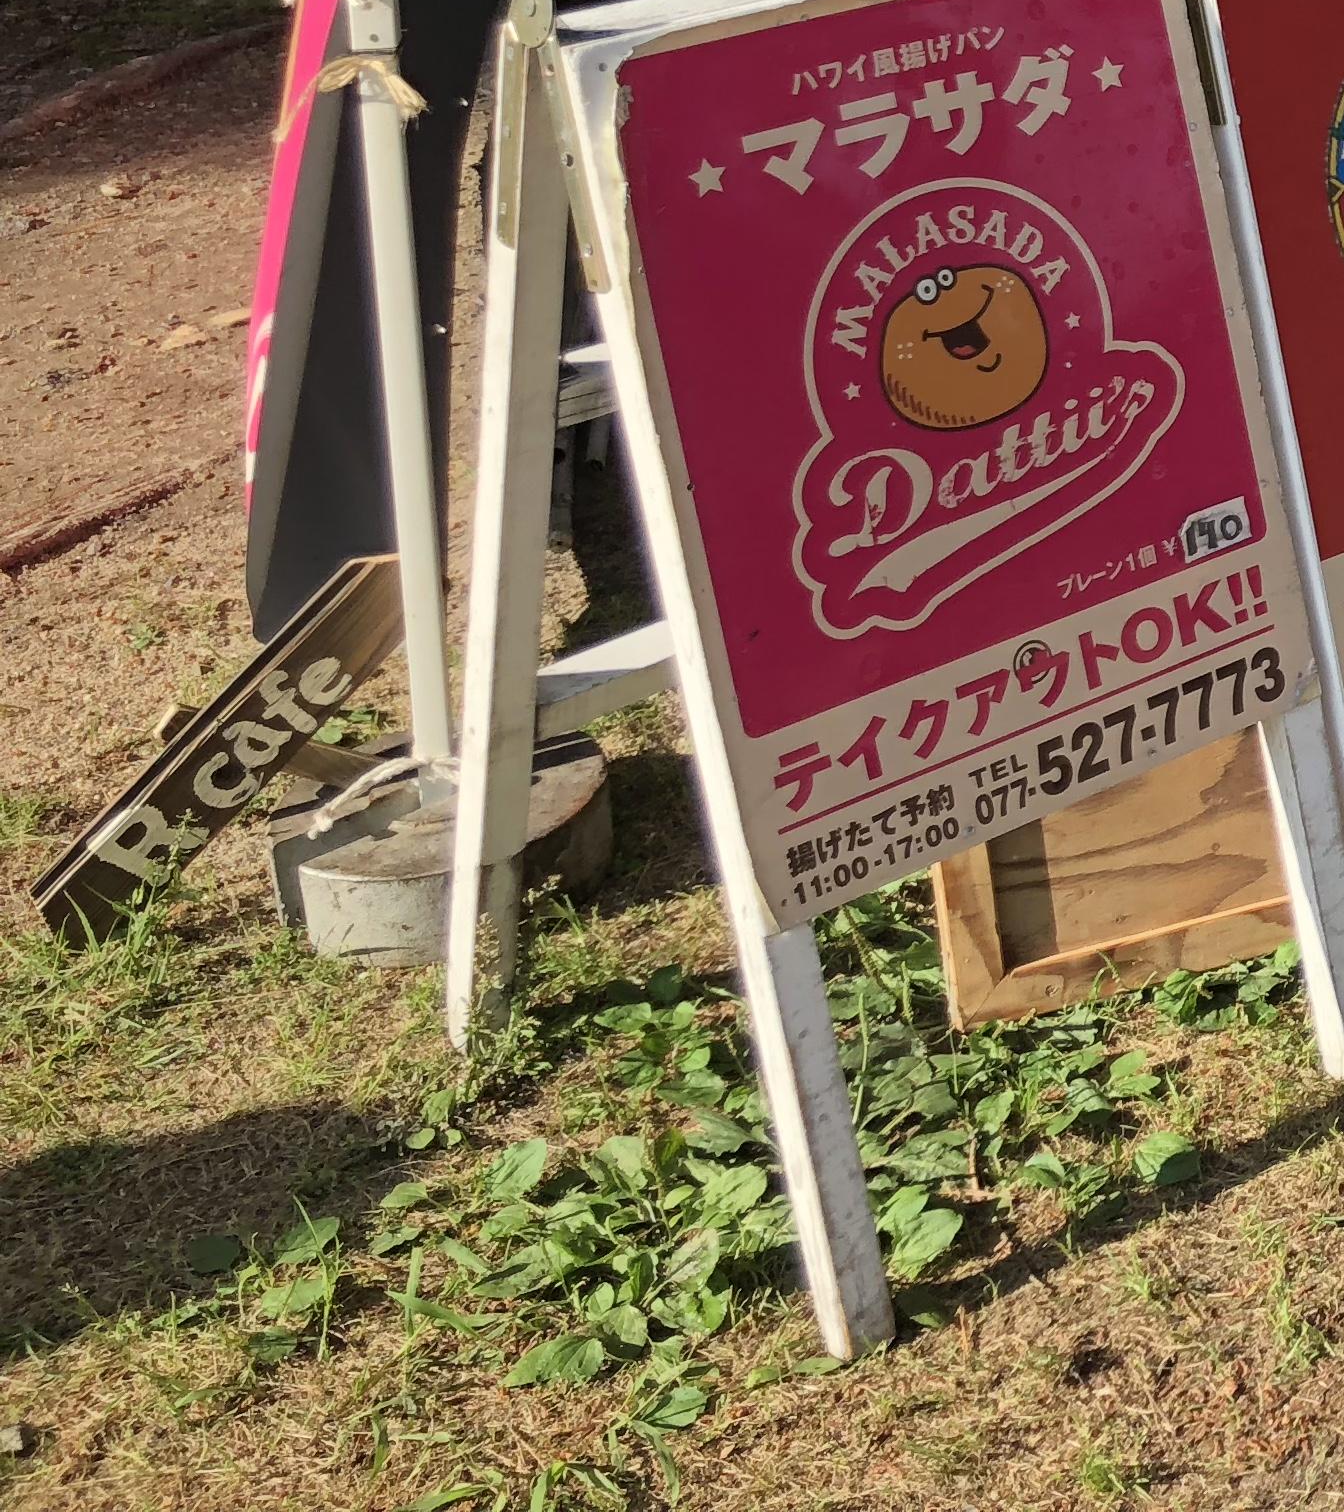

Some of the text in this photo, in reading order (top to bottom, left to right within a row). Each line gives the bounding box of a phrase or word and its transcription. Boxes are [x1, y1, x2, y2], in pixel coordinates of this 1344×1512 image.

[740, 42, 1083, 197] マラサダ
[791, 26, 1006, 97] ハワイ風揚げパン
[830, 205, 1072, 360] MALASADA
[773, 564, 1271, 814] テイクアウトOK!!
[88, 656, 353, 887] R Cafe
[785, 753, 1030, 877] 揚げたて予約 TEL
